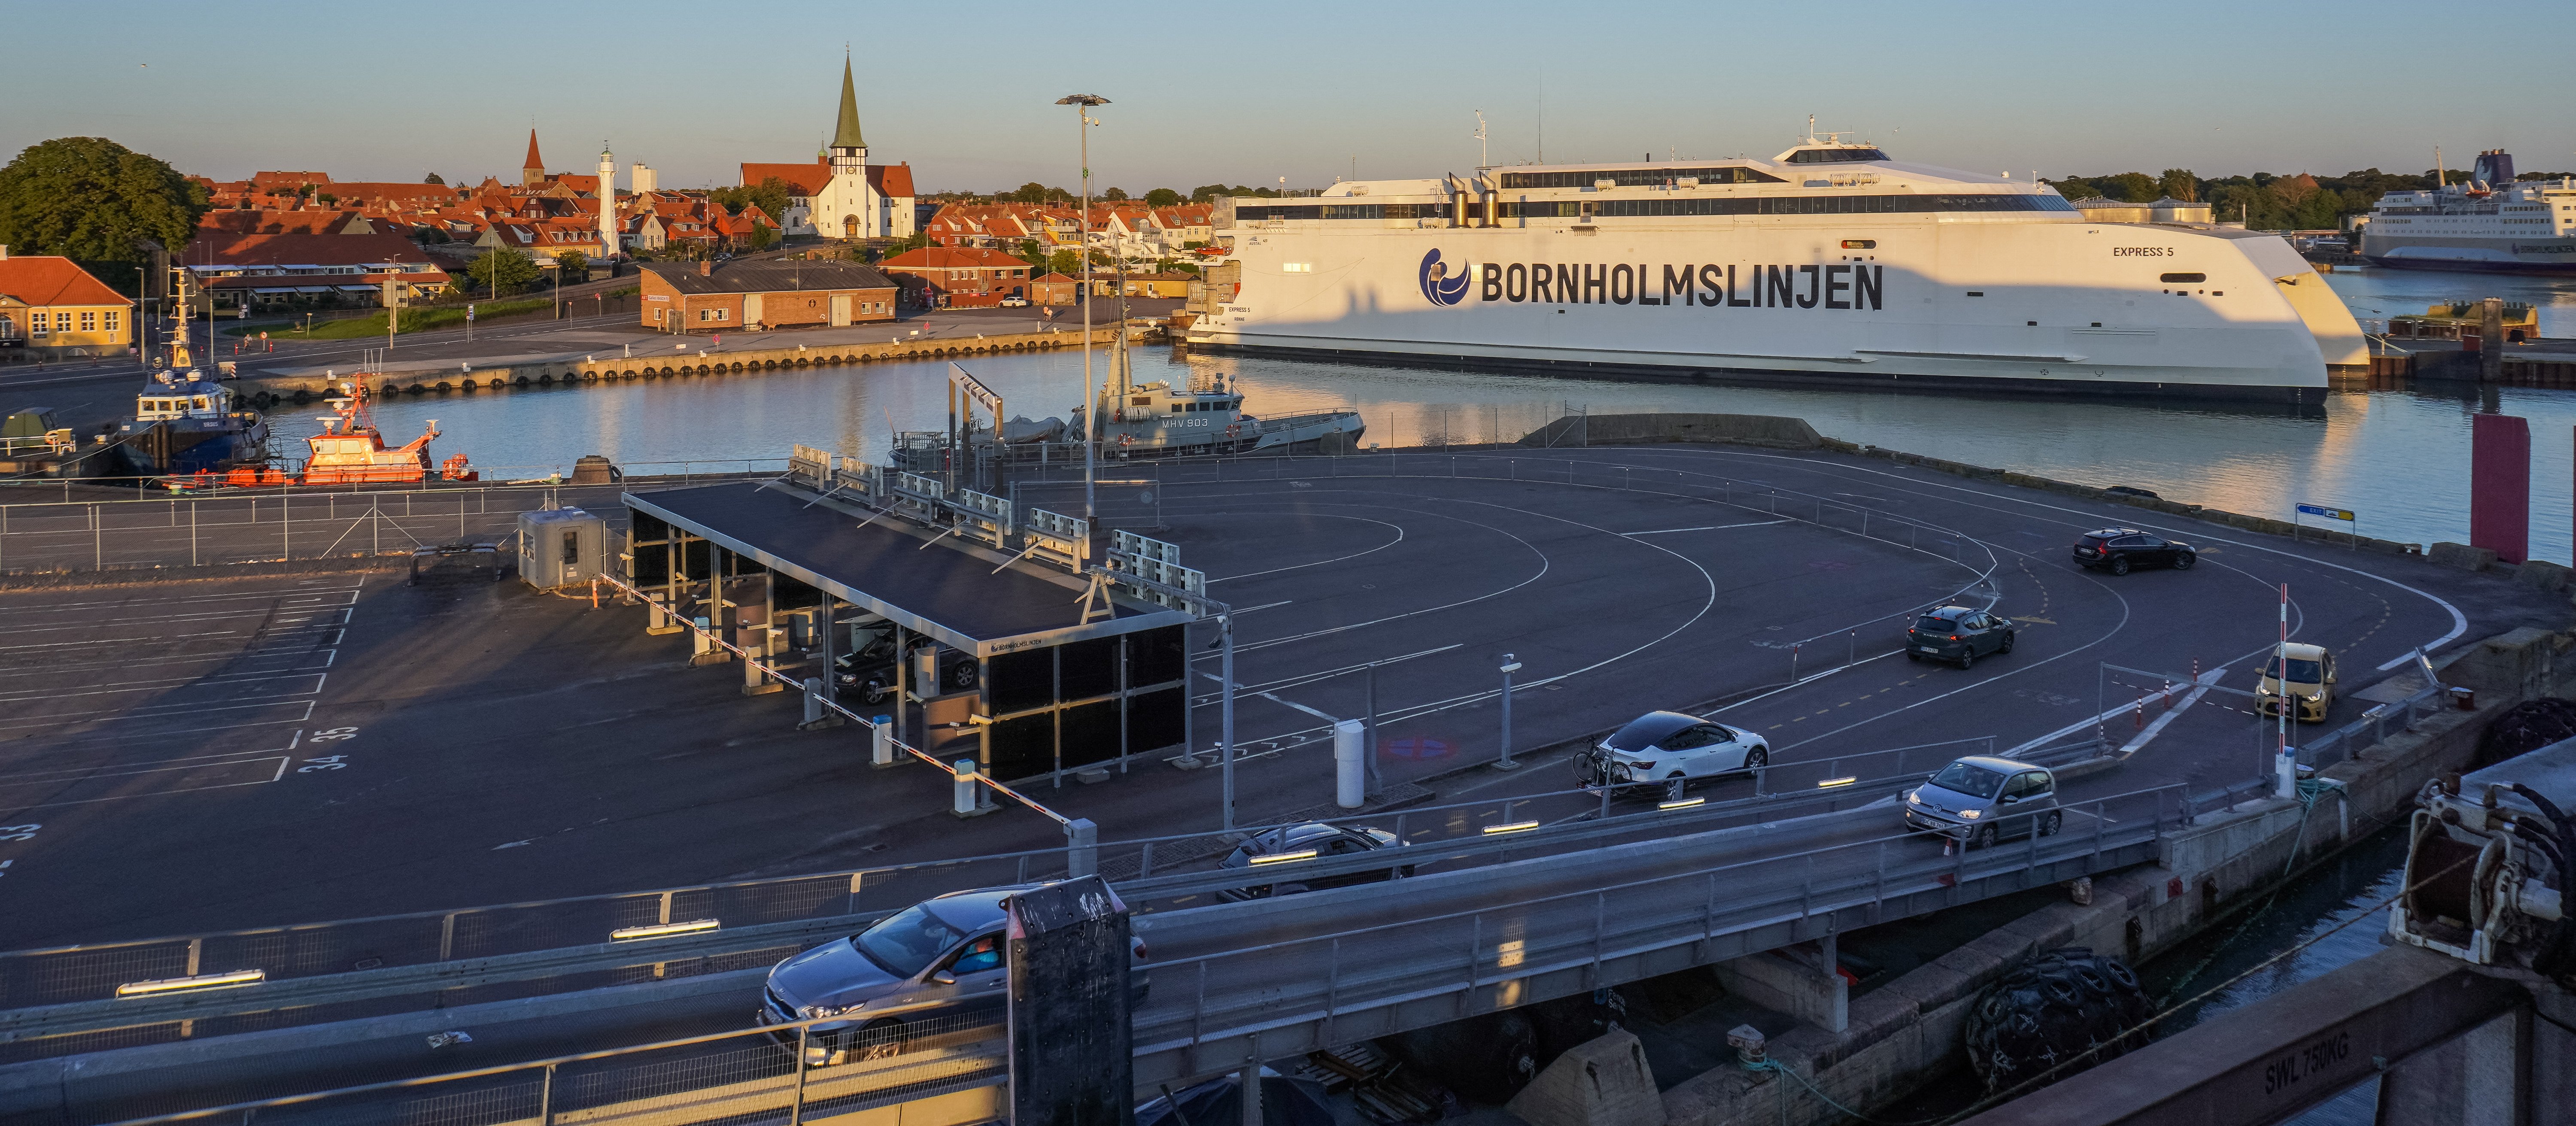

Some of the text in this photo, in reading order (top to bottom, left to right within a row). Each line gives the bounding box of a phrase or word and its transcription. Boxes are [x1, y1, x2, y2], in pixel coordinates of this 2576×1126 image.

[2114, 247, 2174, 256] EXPRESS 5
[1482, 263, 1882, 310] BORNHOLMSLINJEN
[1162, 418, 1208, 429] MHV 903
[999, 639, 1042, 651] BORNHOLMSLINJEN
[310, 727, 359, 742] 35
[297, 755, 349, 773] 34
[2265, 1031, 2349, 1095] SWL 750KG
